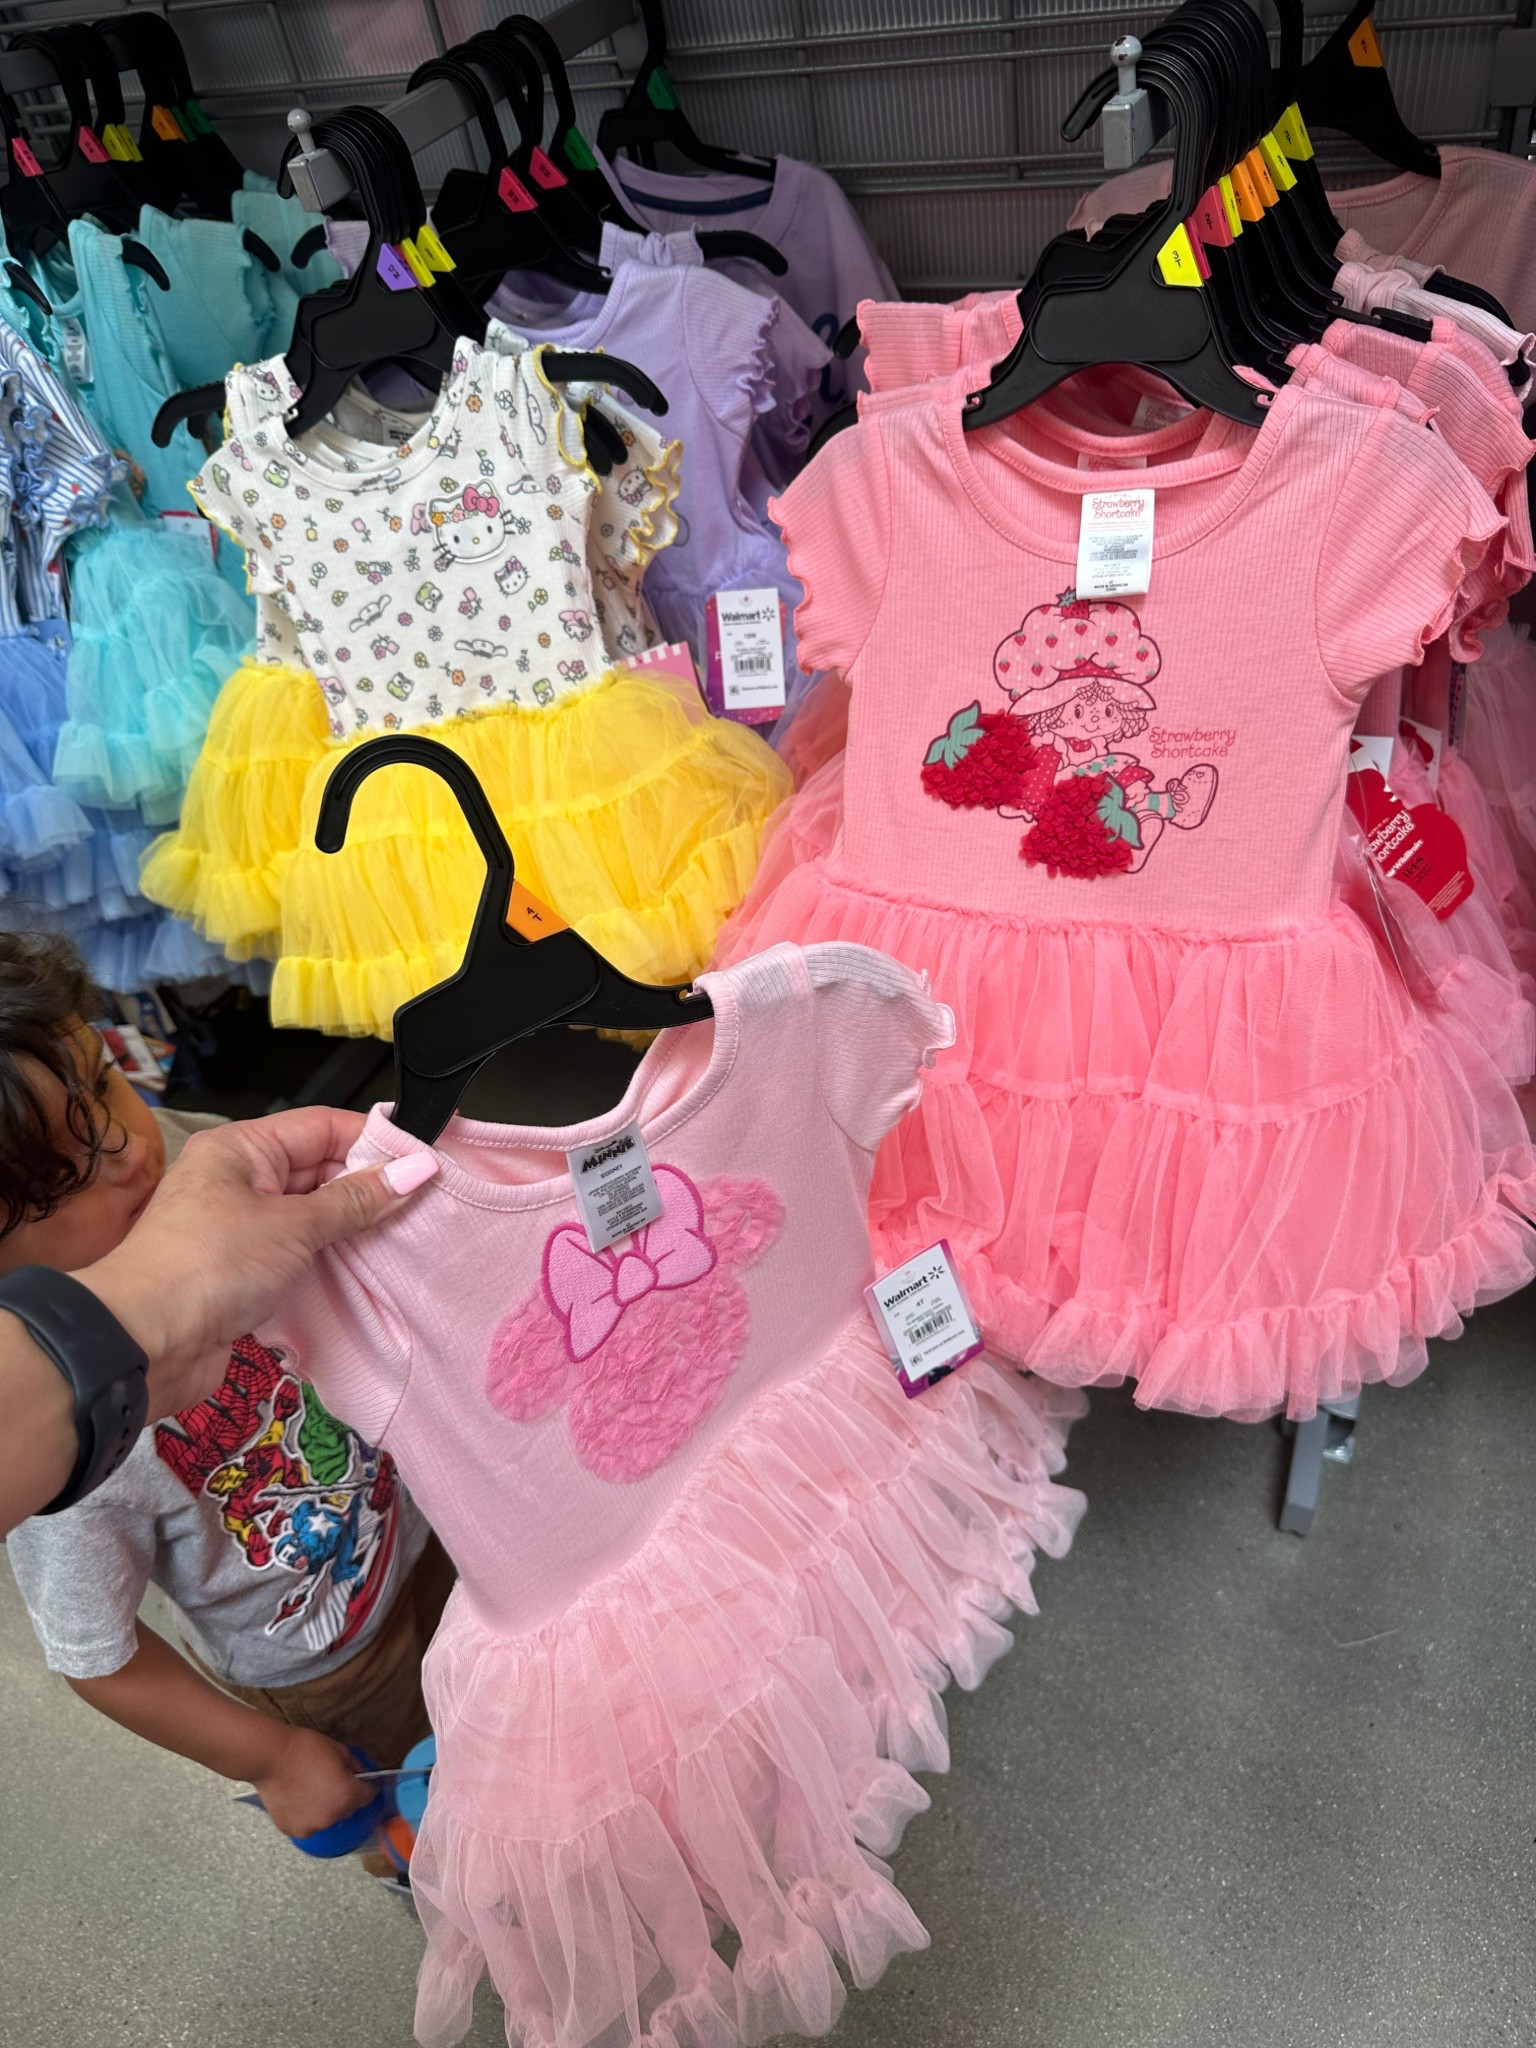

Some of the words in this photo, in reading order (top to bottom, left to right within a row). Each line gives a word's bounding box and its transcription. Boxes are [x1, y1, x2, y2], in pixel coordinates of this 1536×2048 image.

[1092, 497, 1145, 512] Strawberry
[1093, 507, 1141, 519] Shortcake
[721, 610, 761, 622] Walmart
[1149, 726, 1236, 746] Strawberry
[1150, 742, 1228, 758] Shortcake
[884, 1275, 928, 1308] Walmart
[916, 1298, 925, 1307] 4T
